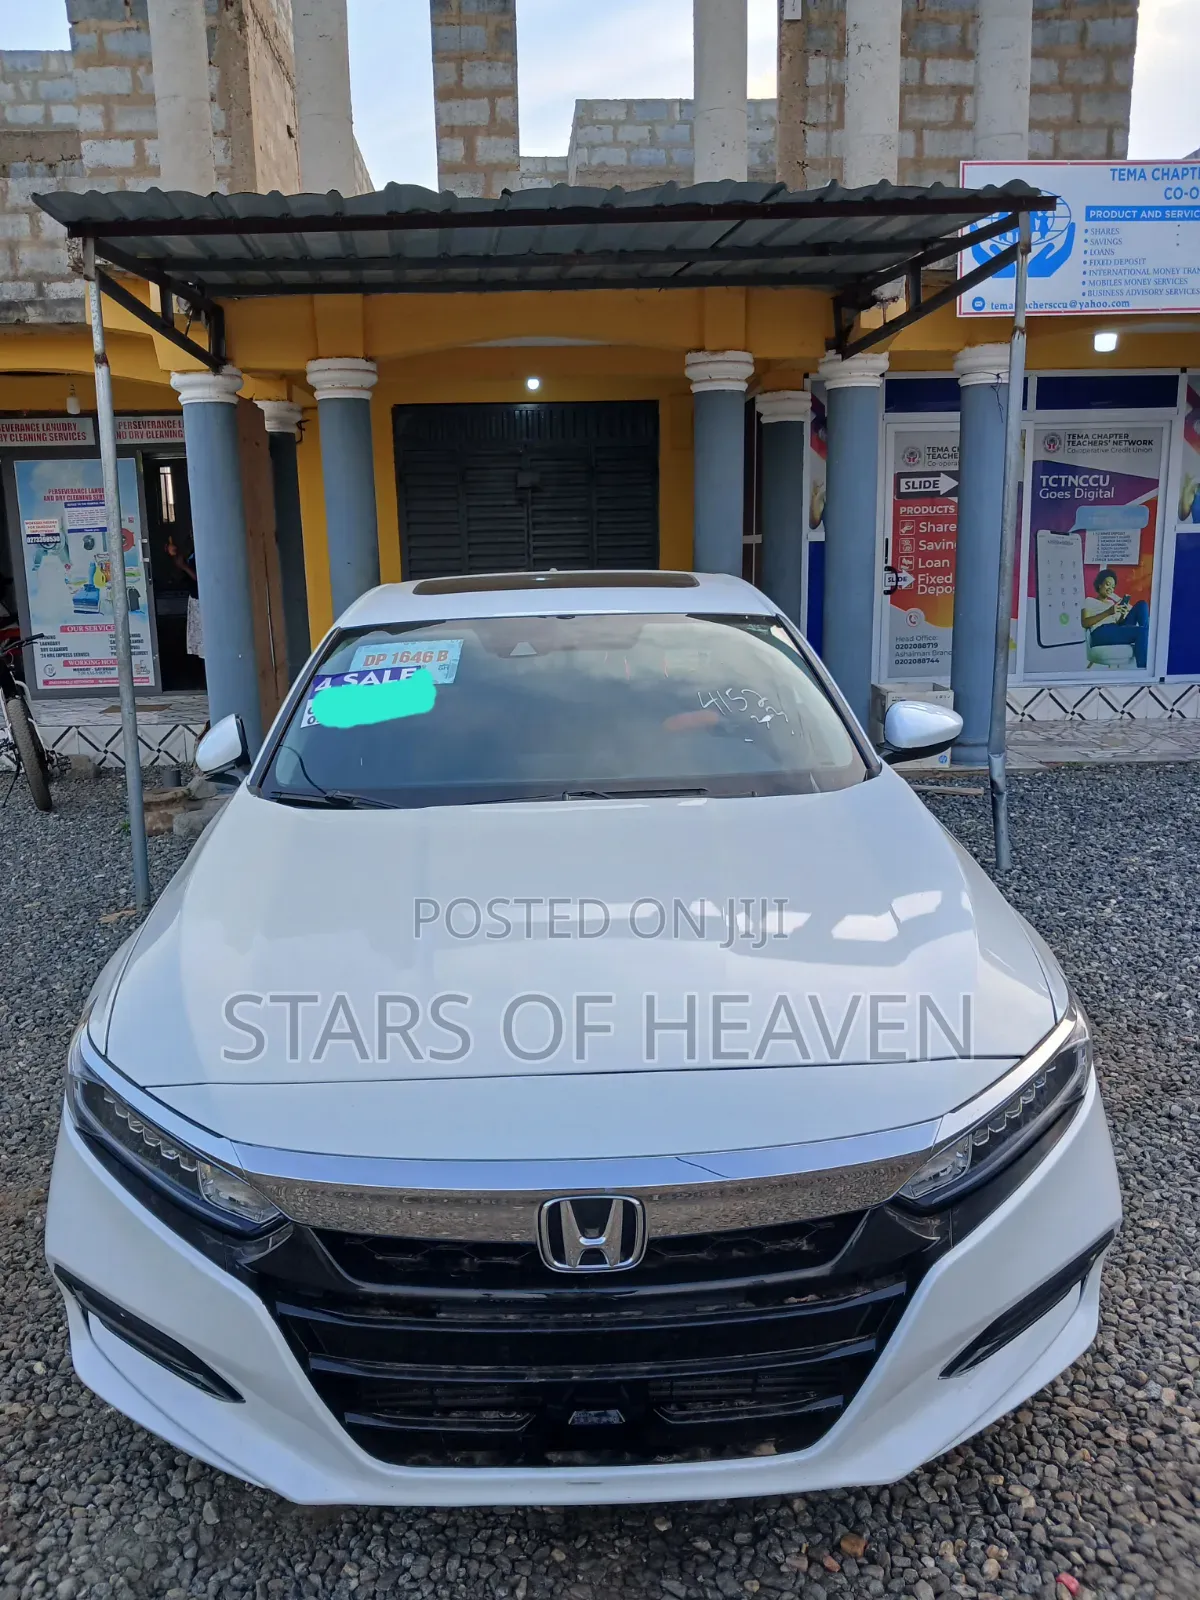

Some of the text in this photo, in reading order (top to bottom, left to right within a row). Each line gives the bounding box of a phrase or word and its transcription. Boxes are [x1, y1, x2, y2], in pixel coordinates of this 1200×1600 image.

[1110, 167, 1200, 181] TEMA CHAPT
[1164, 187, 1200, 200] CO-O
[1090, 210, 1138, 219] PRODUCT
[1140, 210, 1162, 219] AND
[1090, 227, 1120, 235] SHARES
[1090, 238, 1123, 246] SAVINGS
[1089, 248, 1115, 256] LOANS
[1089, 268, 1150, 276] INTERNATIONAL
[1088, 277, 1188, 287] MOBILES MONEY SERVICES
[1087, 287, 1200, 297] BUSINESS ADVISORY SERVICES
[0, 423, 40, 432] EVERANCE
[118, 420, 177, 429] PERSEVERANCE
[10, 432, 47, 442] CLEANING
[49, 431, 87, 441] SERVICES
[129, 431, 143, 439] DRY
[146, 429, 184, 438] CLEANING
[904, 479, 940, 490] SLIDE
[1040, 474, 1110, 487] TCTNCCU
[1039, 487, 1115, 501] Goes Digital
[900, 505, 955, 514] PRODUCTS
[919, 521, 957, 533] Share
[919, 539, 956, 551] Savin
[919, 557, 950, 569] Loan
[918, 573, 952, 585] Fixed
[363, 650, 449, 667] DP 1646 B
[314, 667, 418, 692] 4 SALE
